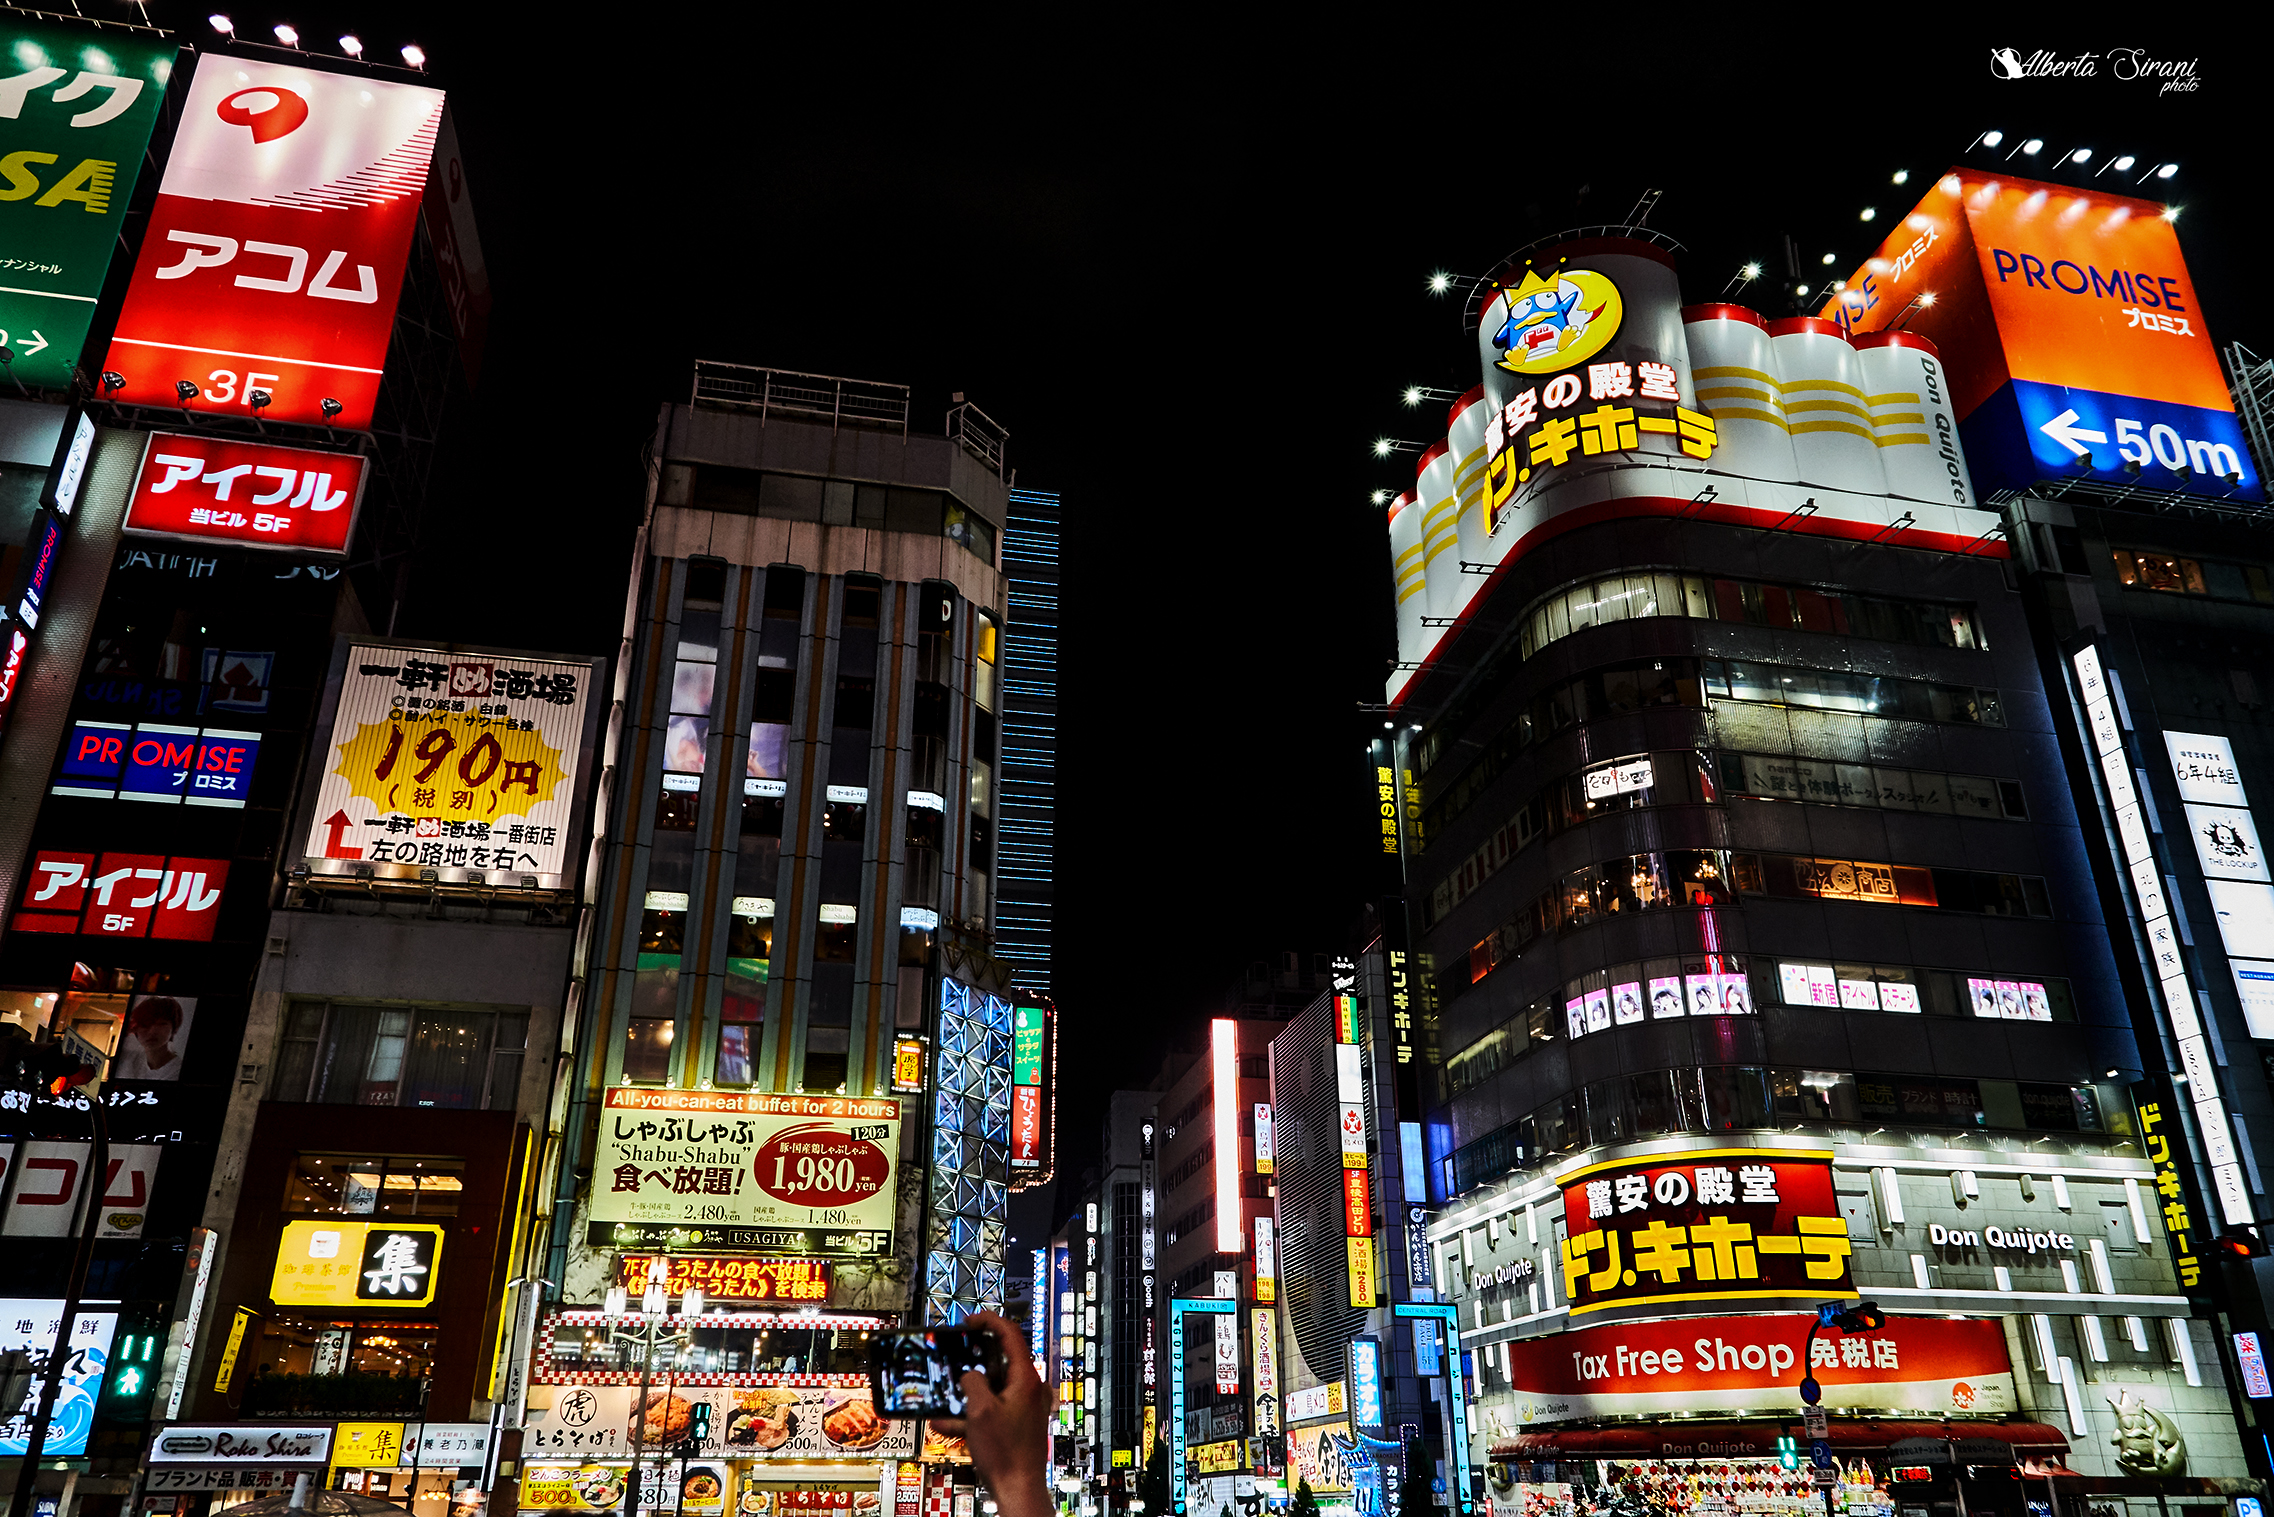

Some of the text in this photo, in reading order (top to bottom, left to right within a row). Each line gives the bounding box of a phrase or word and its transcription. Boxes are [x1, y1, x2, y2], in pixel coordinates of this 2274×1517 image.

[156, 229, 378, 304] アコム
[1992, 248, 2186, 313] PROMISE
[2122, 308, 2195, 337] プロミス
[204, 368, 280, 406] 3F
[1920, 356, 1967, 505] Don Quijote
[2115, 417, 2245, 480] 50m
[151, 453, 347, 512] アイフル
[189, 508, 291, 533] 当ビル 5F
[33, 526, 57, 590] PROMISE
[78, 735, 247, 773] PROMISE
[172, 771, 237, 791] プロミス
[2177, 762, 2239, 785] 6年4組
[1376, 766, 1398, 854] 驚安の殿堂
[368, 838, 539, 872] 左の路地を右へ
[34, 861, 221, 911] アイフル
[102, 914, 135, 931] 5F
[1811, 982, 1837, 1006] 新宿
[1016, 1056, 1040, 1064] スイーツ
[611, 1091, 895, 1117] All-you-can-eat buffet for 2 hours
[614, 1116, 756, 1144] しゃぶしゃぶ
[854, 1126, 887, 1141] 120分
[1019, 1095, 1037, 1158] ひょうたん
[0, 1157, 147, 1208] コム
[611, 1164, 746, 1195] 食べ放題!
[771, 1156, 877, 1195] 1,980 yen
[1349, 1178, 1365, 1235] 豊後高田どり
[1586, 1165, 1779, 1219] 驚安の殿堂
[724, 1212, 740, 1222] yen
[845, 1216, 862, 1226] yen
[734, 1232, 888, 1252] USAGIYA 当ビル 5F
[1930, 1223, 2075, 1254] Don Quijote
[363, 1233, 428, 1295] 集
[1473, 1257, 1533, 1290] Don Quijote
[1259, 1312, 1271, 1377] きんくら酒場
[1573, 1337, 1899, 1381] Tax Free Shop 免税店
[1219, 1384, 1236, 1395] B1
[1357, 1344, 1380, 1424] カラオケ
[1173, 1327, 1185, 1484] GODZILLA ROAD
[1534, 1402, 1570, 1417] Don Quijote
[213, 1431, 257, 1458] Roko
[369, 1429, 397, 1460] 集
[535, 1428, 608, 1448] とらそば
[785, 1437, 818, 1450] 500円
[881, 1436, 913, 1450] 520円
[1523, 1444, 1560, 1456] Don Quijote
[1663, 1440, 1756, 1456] Don Quijote
[154, 1470, 239, 1488] ブランド品
[528, 1468, 614, 1483] とんこつラーメン
